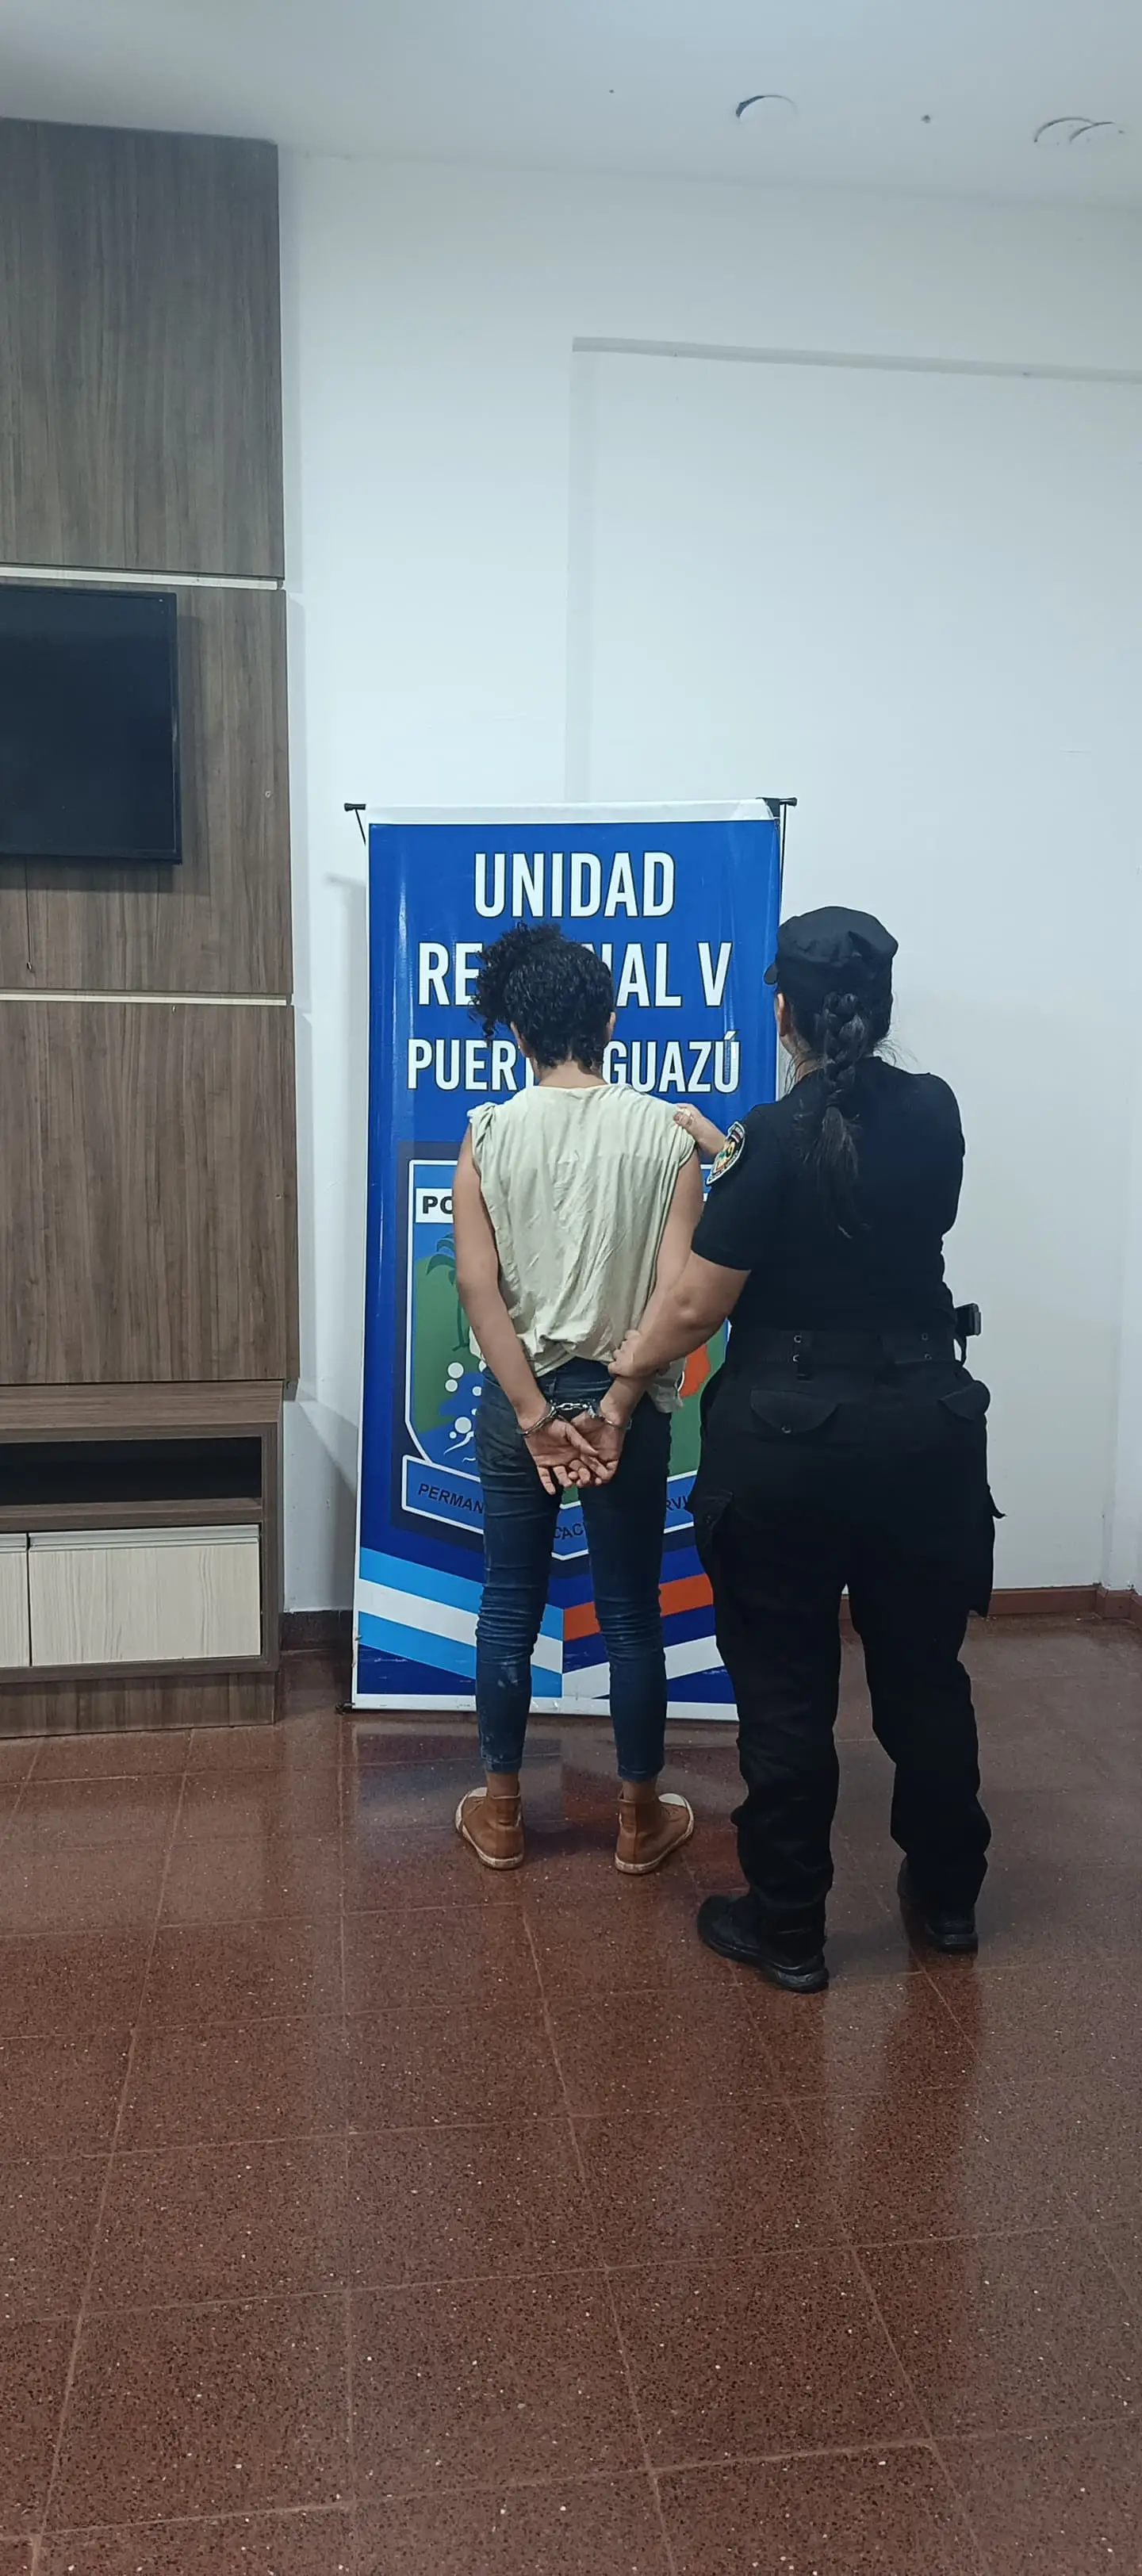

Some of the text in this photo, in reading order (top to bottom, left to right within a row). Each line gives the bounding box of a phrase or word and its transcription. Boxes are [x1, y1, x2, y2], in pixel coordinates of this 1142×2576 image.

[474, 852, 675, 918] UNIDAD
[697, 941, 733, 1007] V
[603, 1030, 740, 1093] GUAZÚ
[418, 1483, 484, 1513] PERMAN
